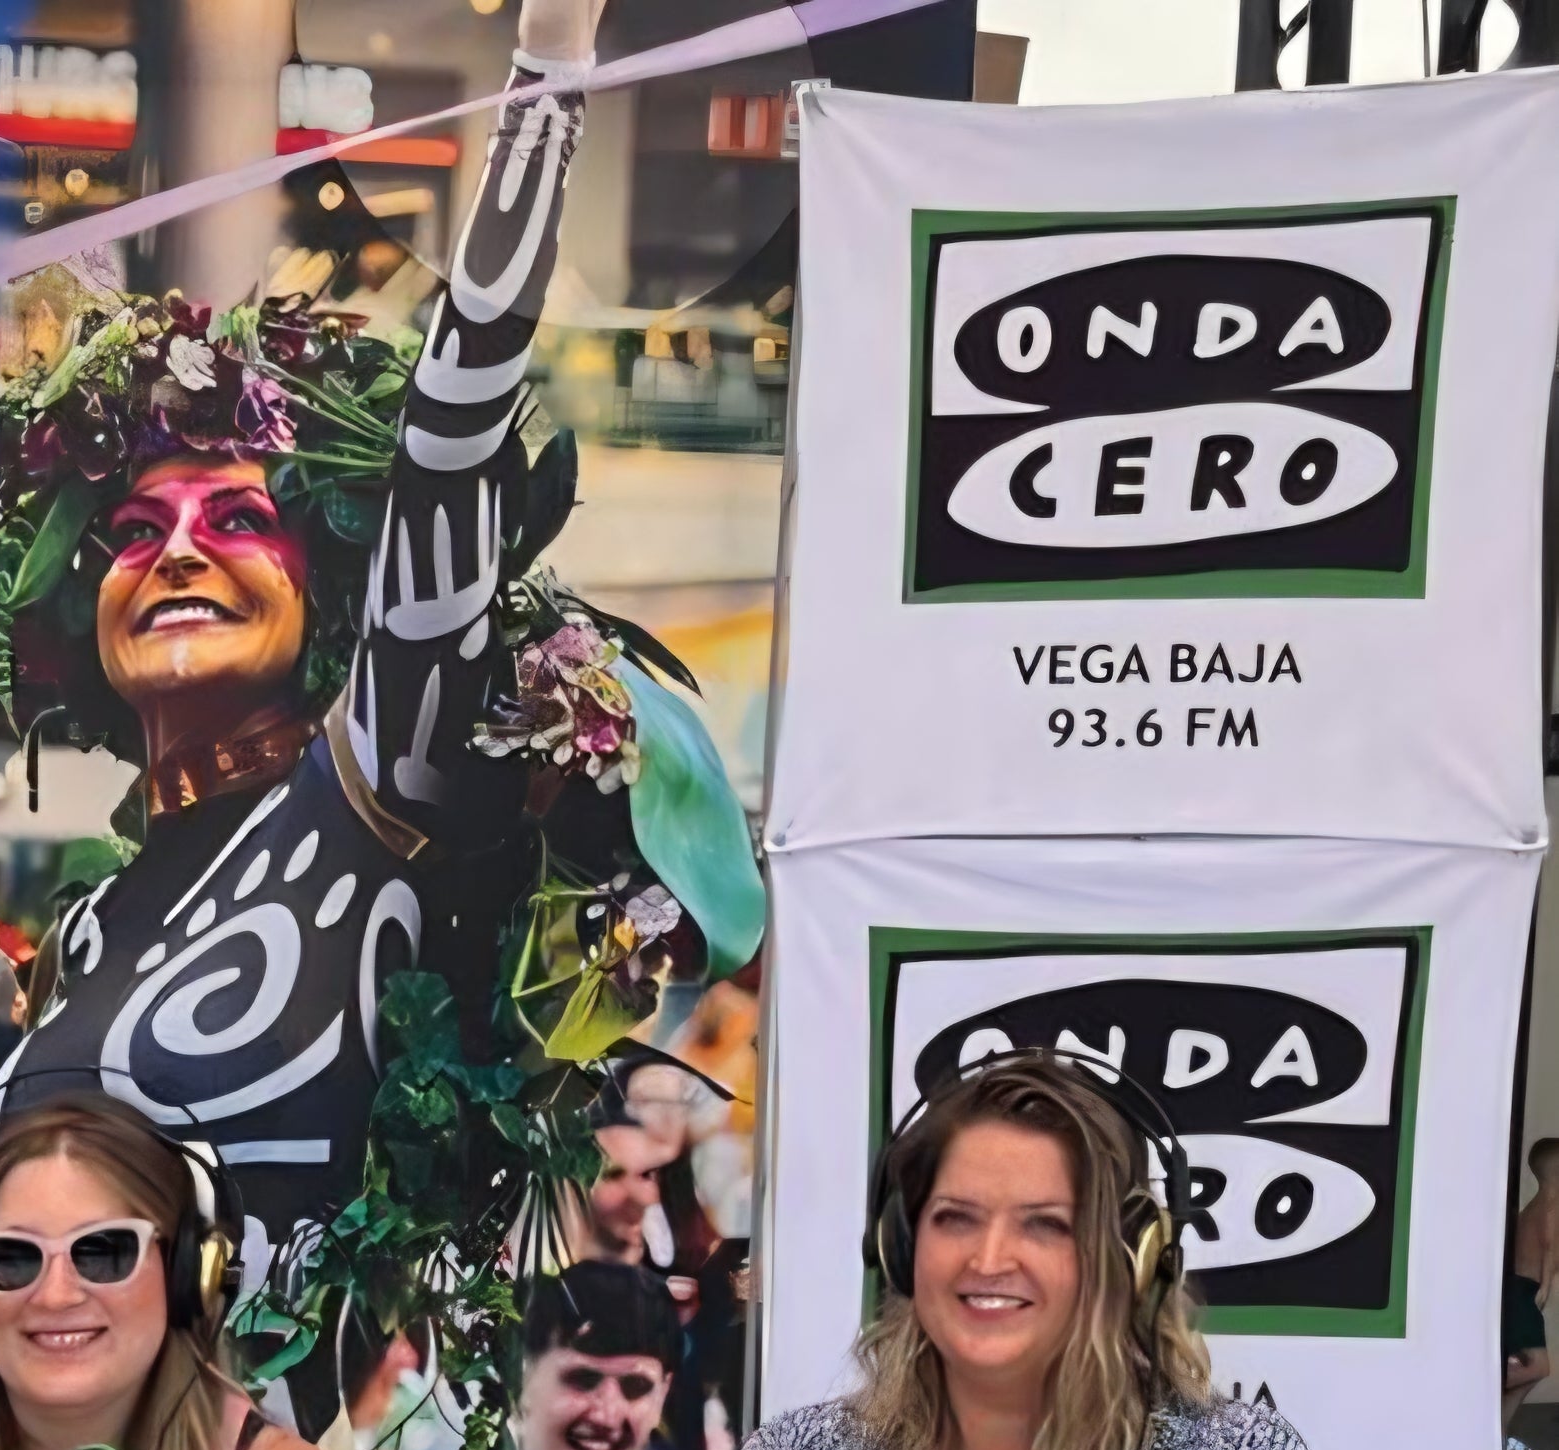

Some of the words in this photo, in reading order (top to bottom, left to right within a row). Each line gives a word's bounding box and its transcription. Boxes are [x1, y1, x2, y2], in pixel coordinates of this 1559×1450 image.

[997, 296, 1344, 373] ONDA
[1009, 434, 1338, 518] CERO
[1013, 643, 1150, 685] VEGA
[1170, 643, 1302, 683] BAJA
[1049, 709, 1162, 748] 93.6
[1187, 708, 1259, 747] FM
